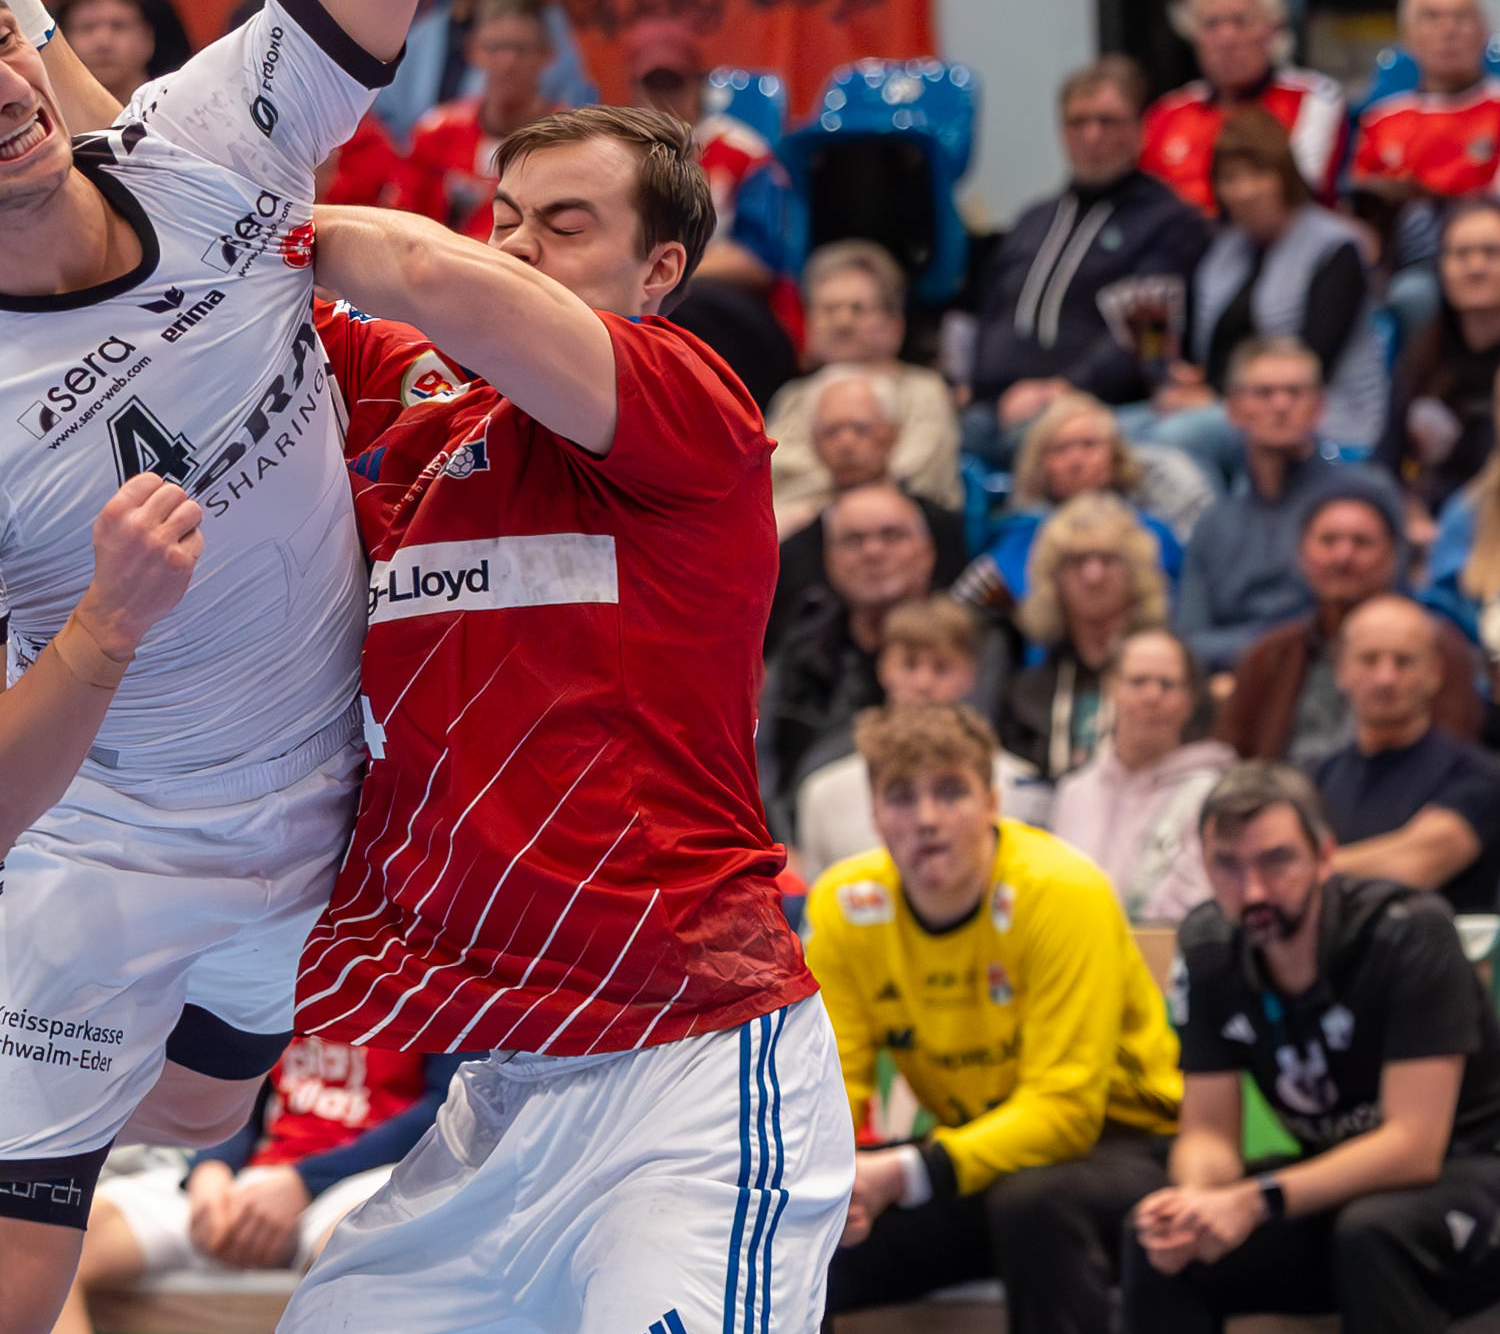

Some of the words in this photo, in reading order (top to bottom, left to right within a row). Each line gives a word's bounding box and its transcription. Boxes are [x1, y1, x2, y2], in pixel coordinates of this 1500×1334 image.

[160, 289, 226, 344] erima
[47, 335, 137, 413] sera
[48, 355, 153, 451] www.sera-web.com
[105, 394, 201, 491] 4
[204, 368, 326, 517] SHARING
[368, 559, 490, 616] g-Lloyd
